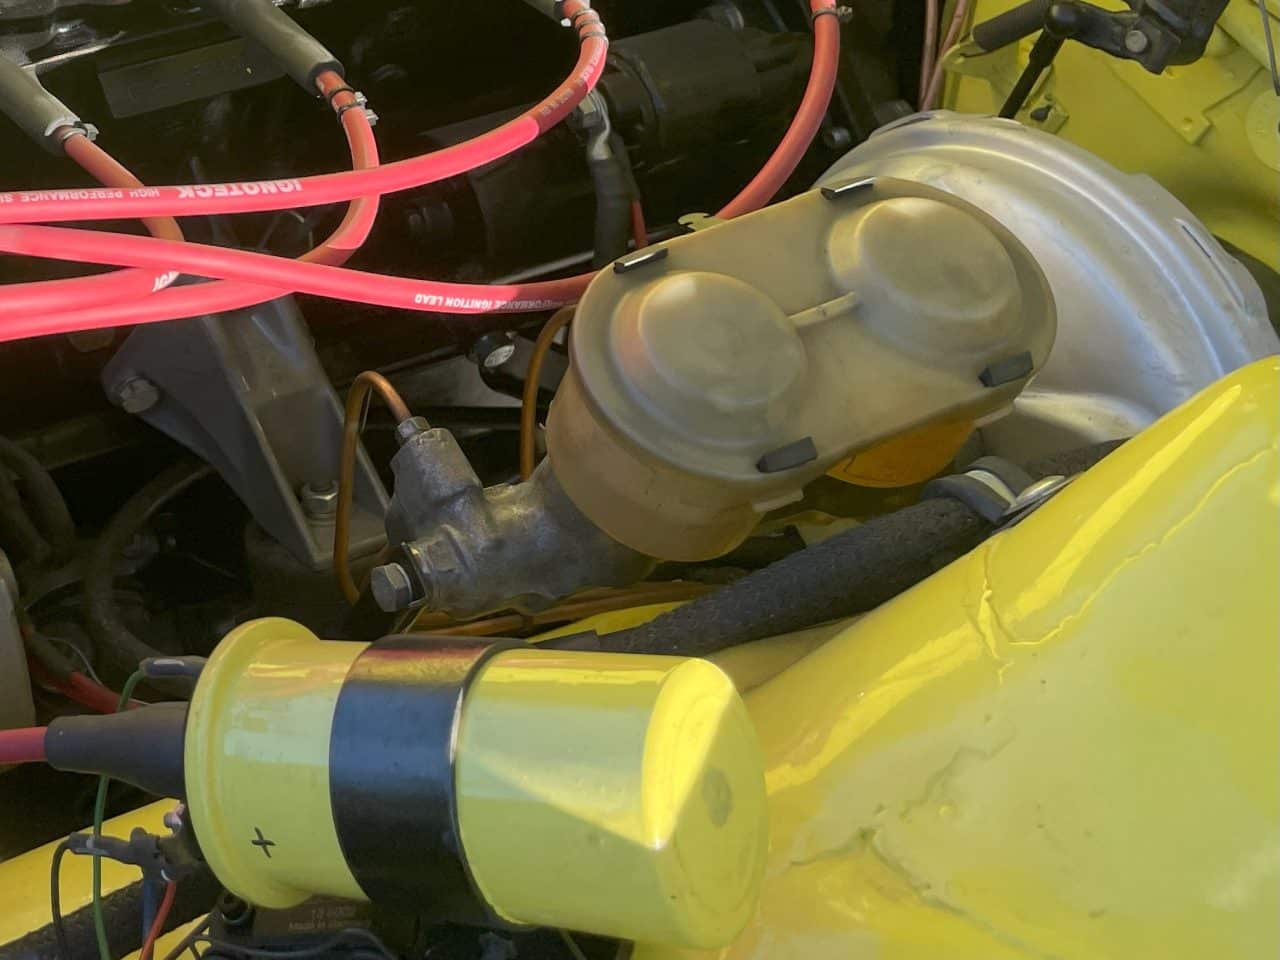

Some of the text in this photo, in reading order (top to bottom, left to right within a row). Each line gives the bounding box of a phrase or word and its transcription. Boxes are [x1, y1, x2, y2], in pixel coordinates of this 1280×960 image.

[22, 189, 123, 203] PERFORMANCE
[129, 188, 160, 199] HIGH
[177, 179, 302, 200] IGNOTECK
[414, 293, 444, 306] LEAD
[445, 297, 493, 310] IGNITION
